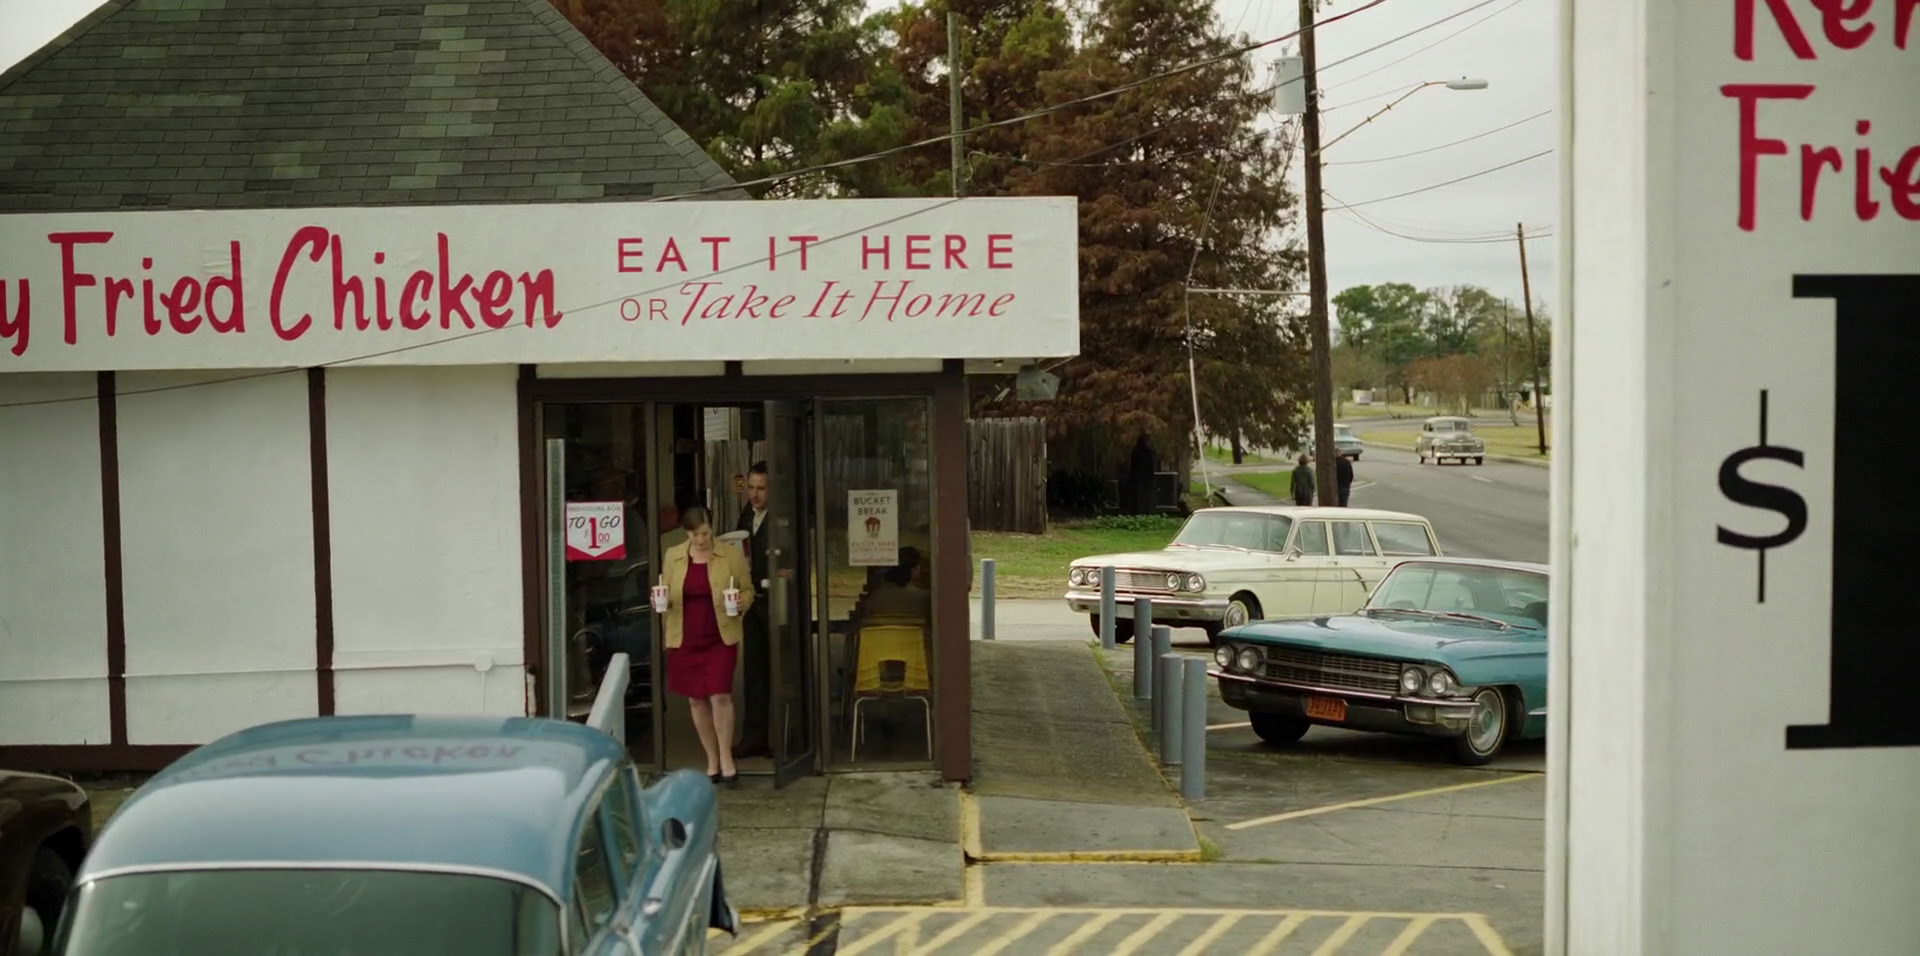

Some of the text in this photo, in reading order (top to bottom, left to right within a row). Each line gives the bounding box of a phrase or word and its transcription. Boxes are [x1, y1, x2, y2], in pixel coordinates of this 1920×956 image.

[617, 234, 1014, 272] EAT IT HERE
[48, 231, 246, 344] Fried
[269, 226, 564, 342] Chicken
[620, 280, 1016, 326] OR Take It Home
[853, 496, 891, 505] BUCKET
[569, 515, 620, 529] TO GO
